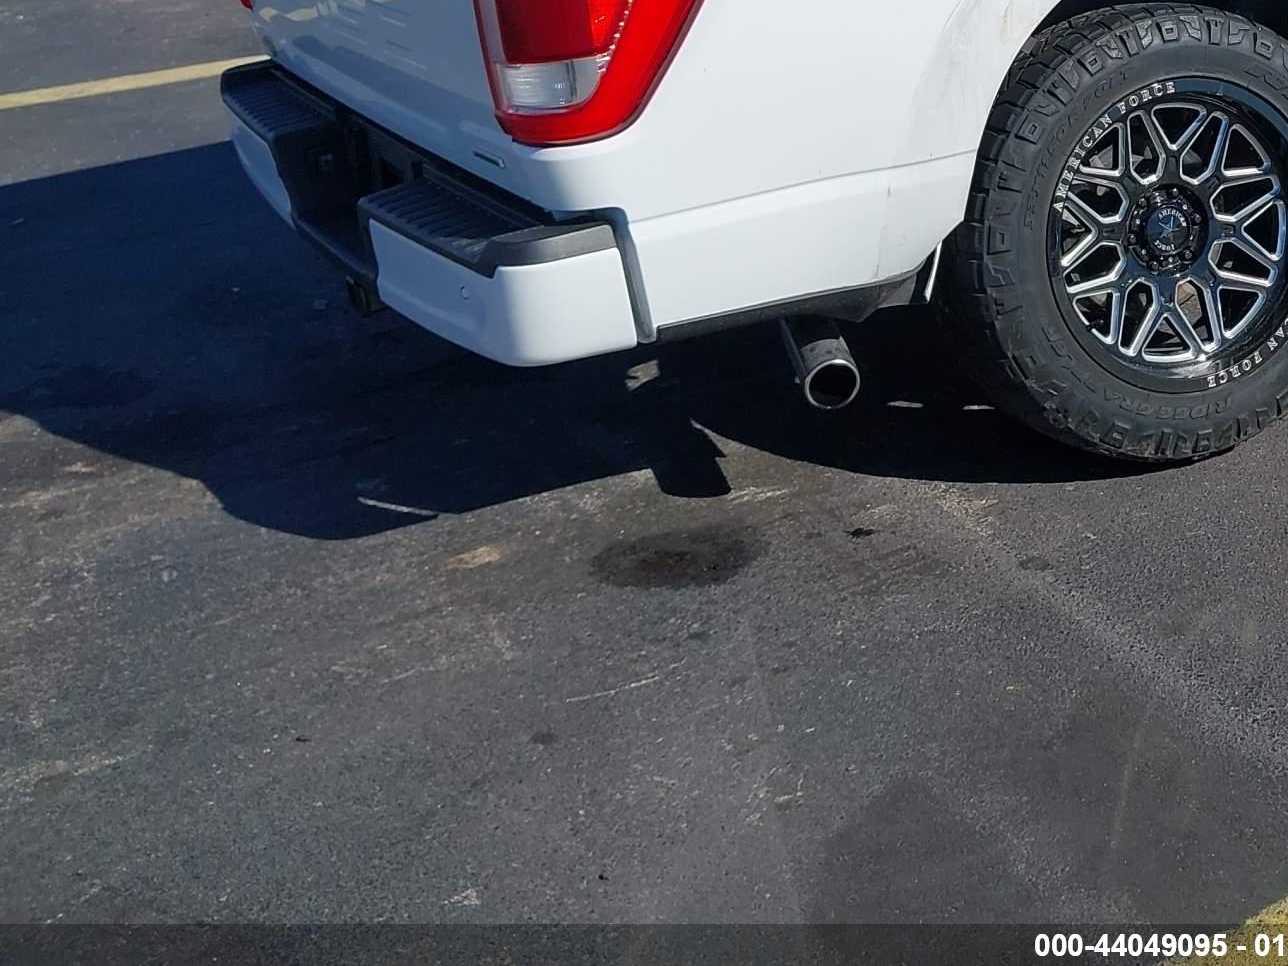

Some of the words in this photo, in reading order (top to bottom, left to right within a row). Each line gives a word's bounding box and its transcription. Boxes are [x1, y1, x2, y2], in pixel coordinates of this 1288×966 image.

[1053, 114, 1113, 212] AMERICAN
[1117, 81, 1176, 115] FORCE
[1207, 350, 1263, 388] FORCE
